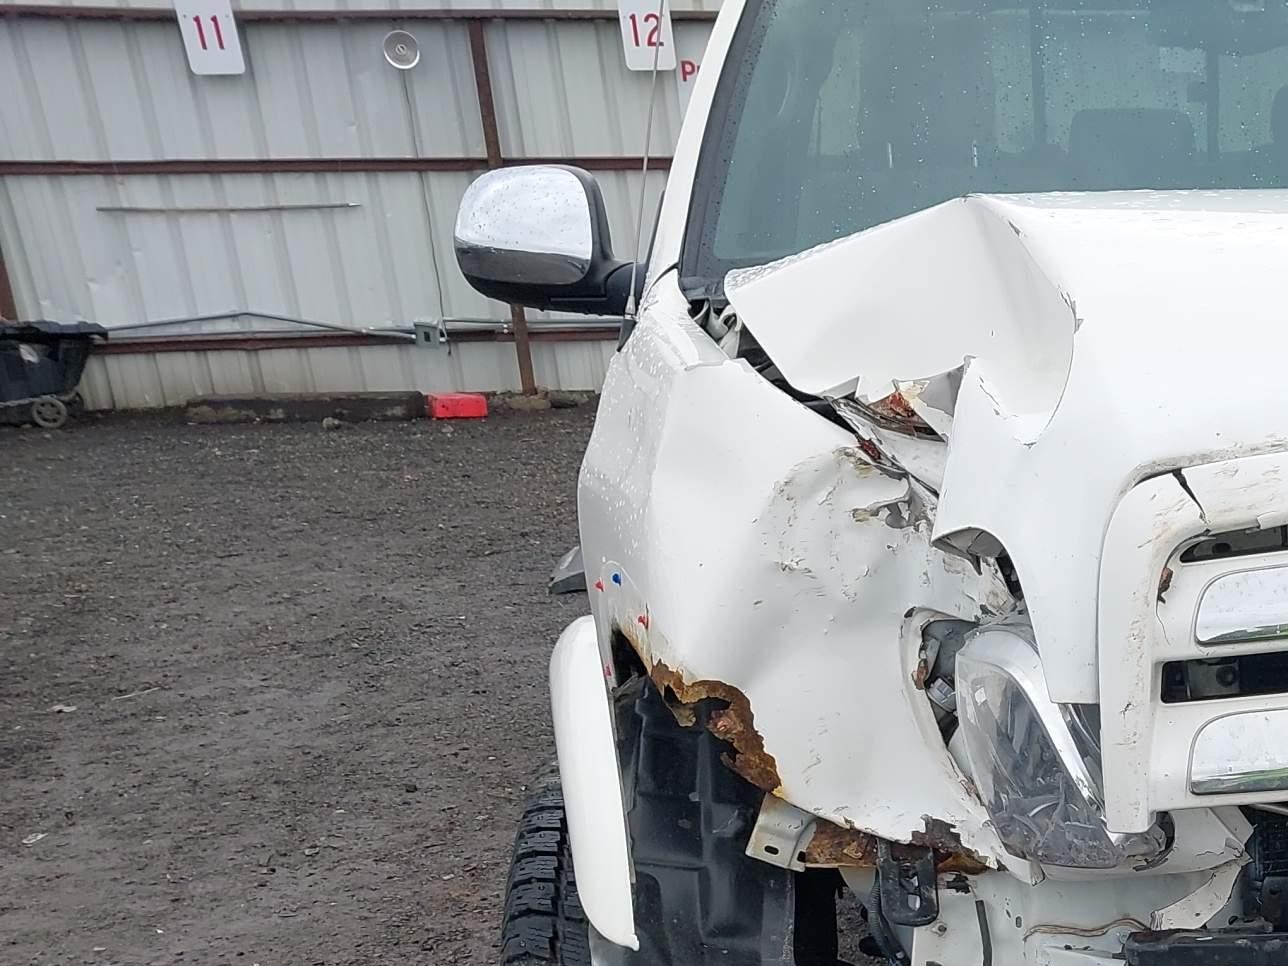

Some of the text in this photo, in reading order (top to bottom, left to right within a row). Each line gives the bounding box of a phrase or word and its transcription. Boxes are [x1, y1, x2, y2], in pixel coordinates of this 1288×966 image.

[193, 15, 225, 50] 11
[629, 13, 664, 47] 12
[680, 60, 700, 82] P
